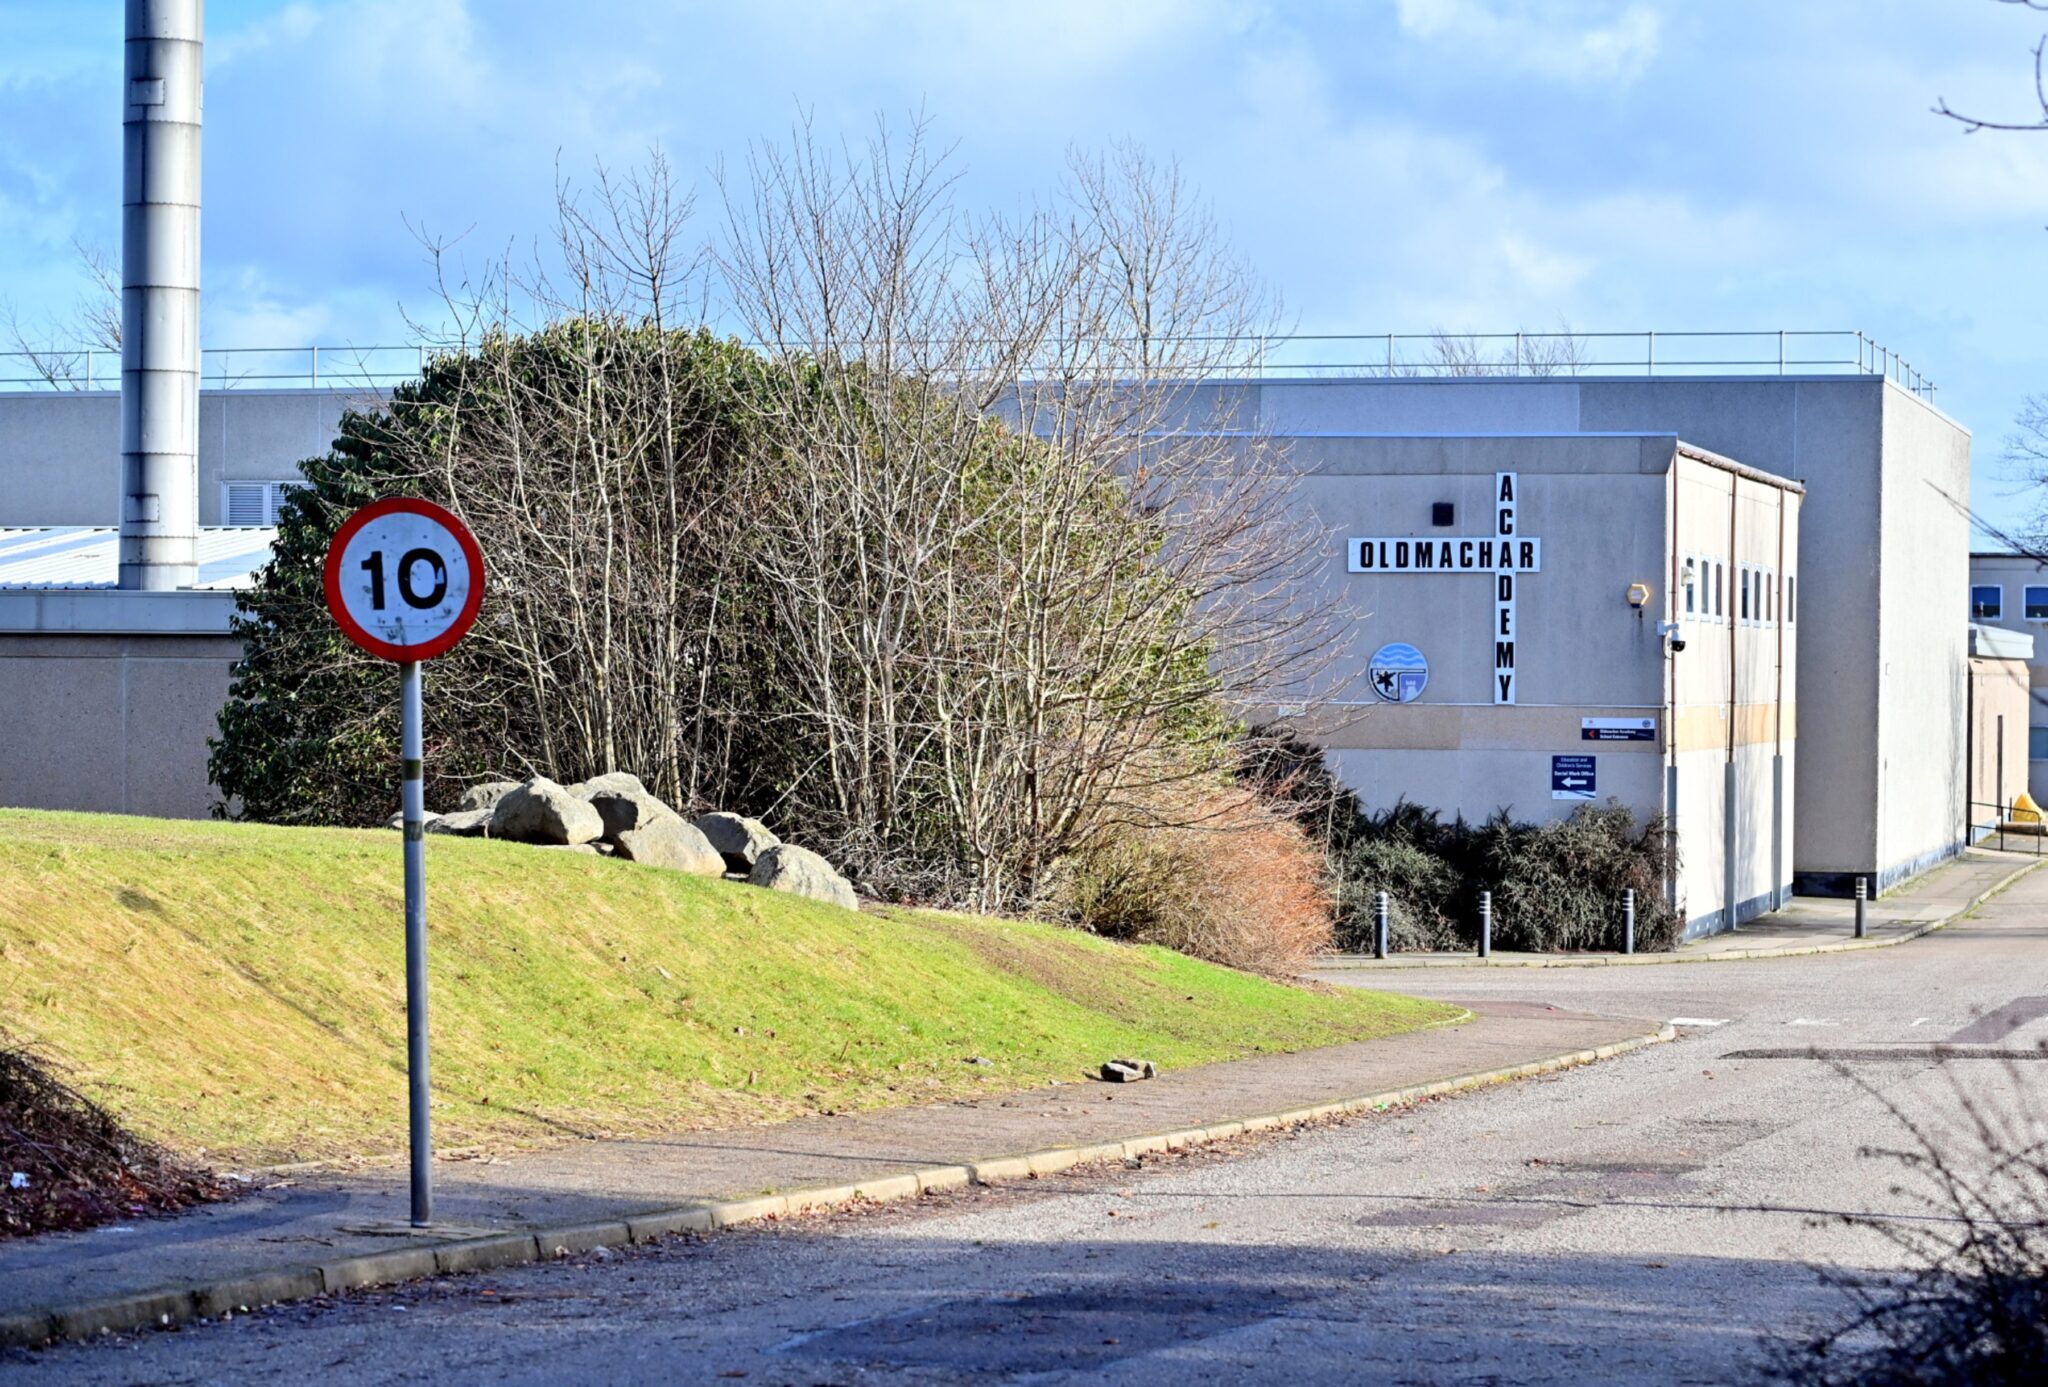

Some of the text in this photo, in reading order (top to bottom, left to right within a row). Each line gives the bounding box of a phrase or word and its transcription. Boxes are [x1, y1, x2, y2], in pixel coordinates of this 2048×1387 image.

[361, 547, 447, 610] 10
[1360, 541, 1534, 568] OLDMACHAR
[1496, 475, 1514, 702] ACADEMY
